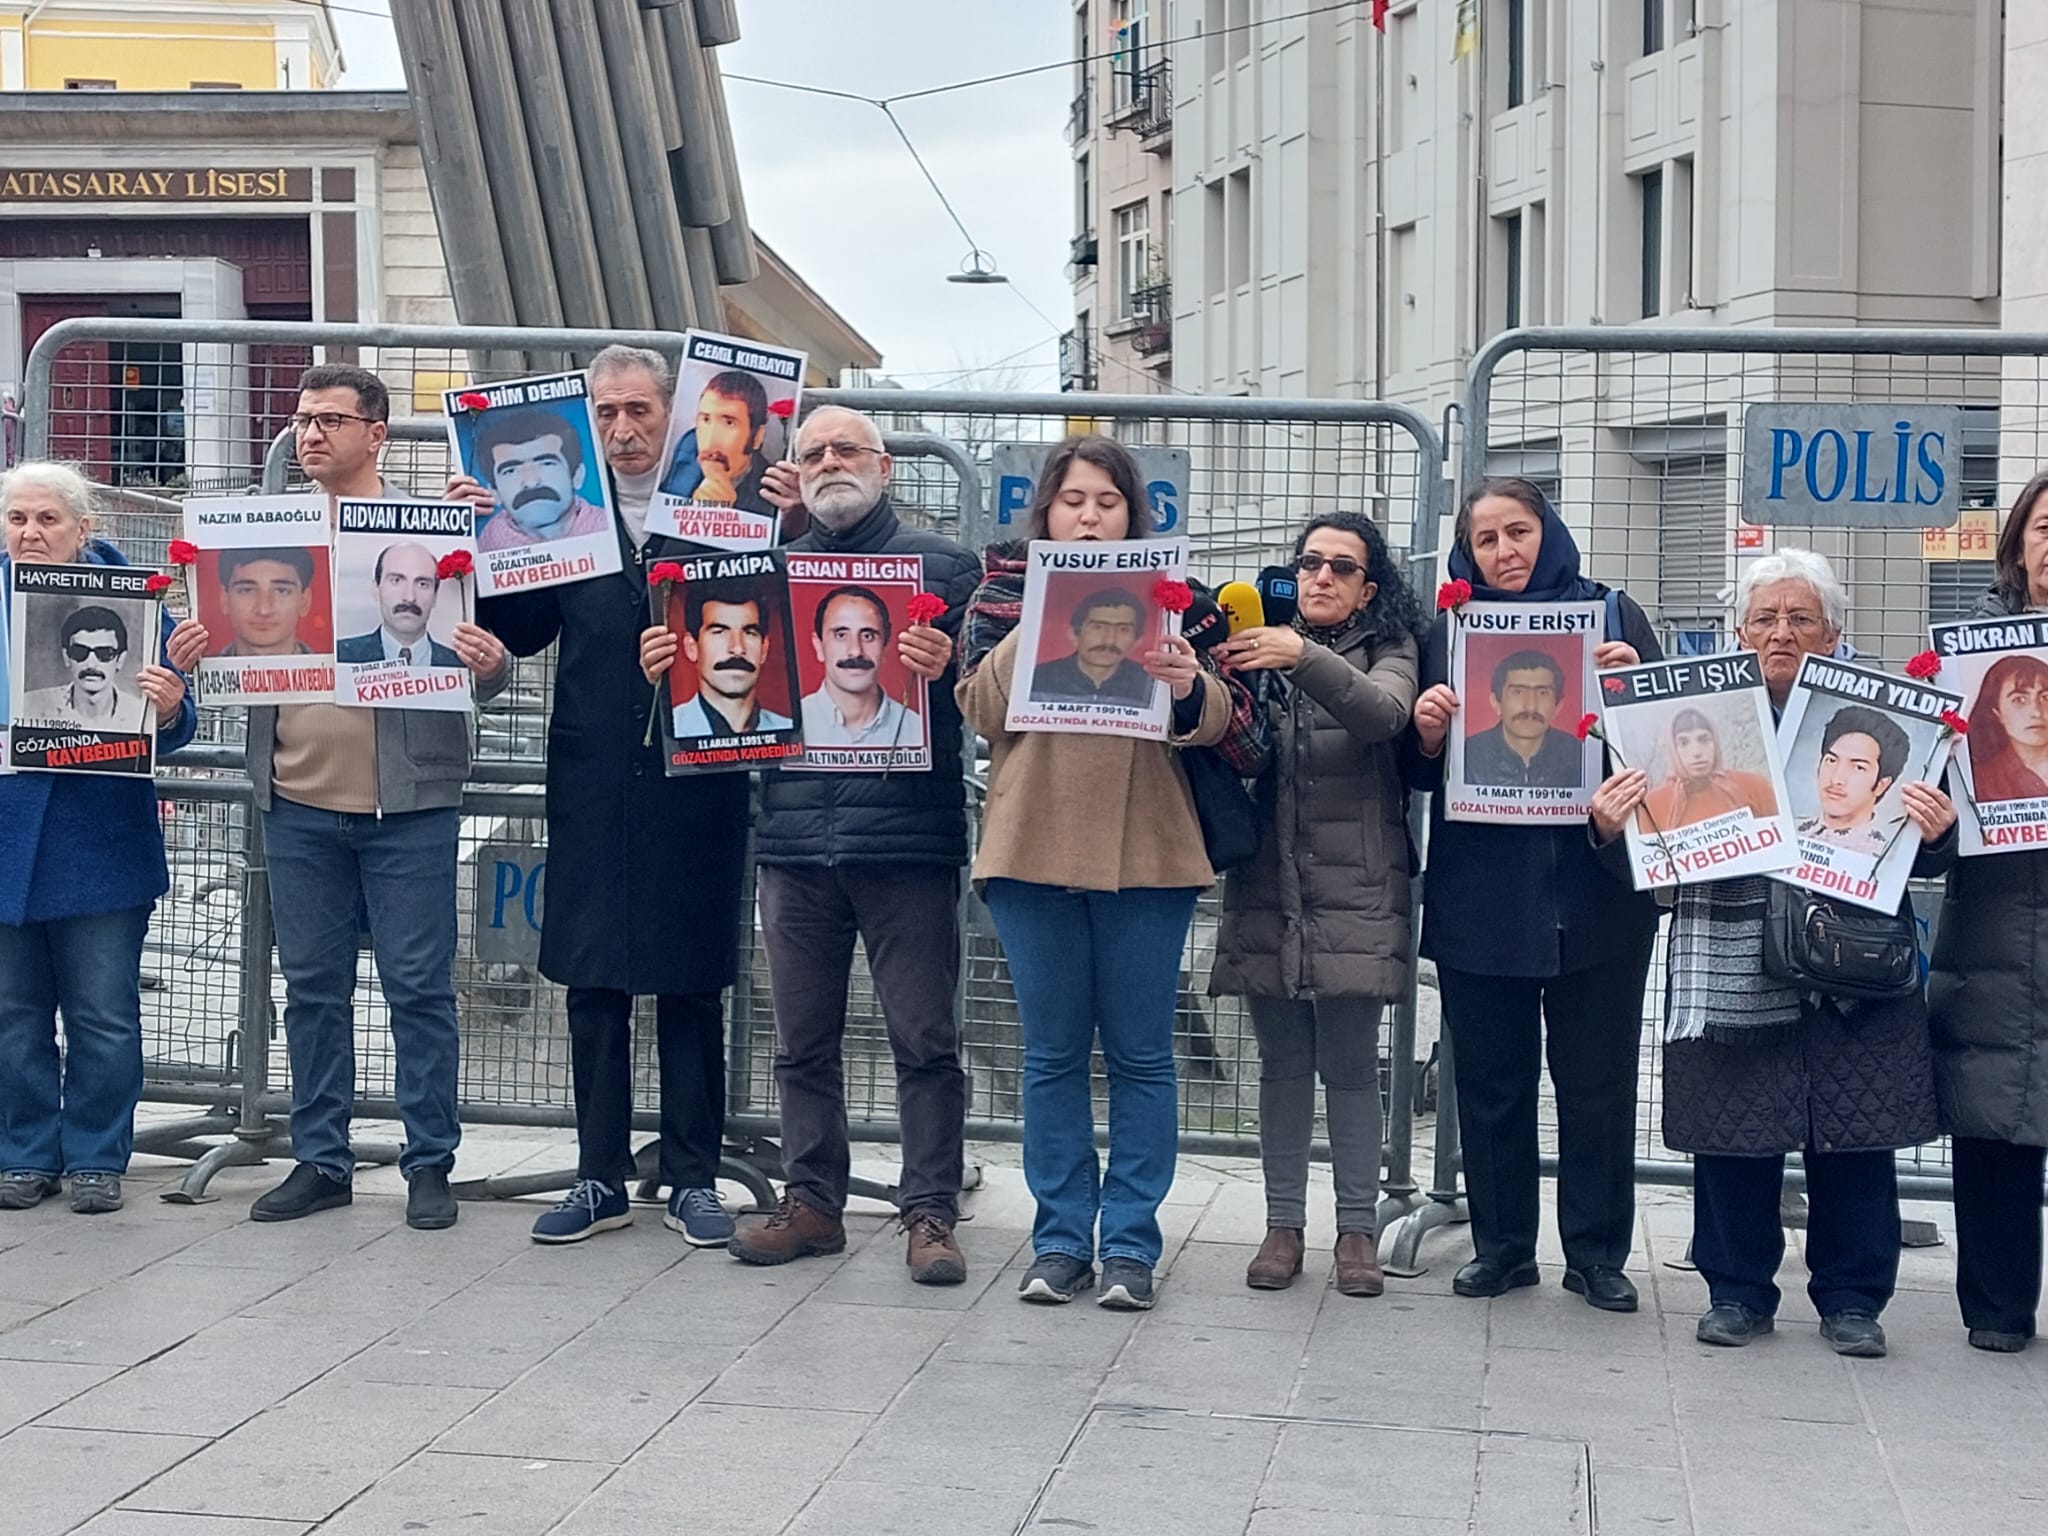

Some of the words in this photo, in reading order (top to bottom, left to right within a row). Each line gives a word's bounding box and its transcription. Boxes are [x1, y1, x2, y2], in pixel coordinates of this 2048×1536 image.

[0, 172, 174, 197] ATASARAY
[185, 168, 288, 197] LİSESİ
[527, 376, 584, 402] DEMİR
[1766, 421, 1945, 505] POLİS
[199, 512, 242, 525] NAZIM
[246, 508, 322, 524] BABAOĞLU
[342, 506, 396, 530] RIDVAN
[400, 507, 471, 536] KARAKOÇ
[673, 508, 740, 522] GÖZALTINDA
[490, 553, 553, 572] GÖZALTINDA
[717, 554, 776, 578] AKİPA
[852, 560, 919, 579] BİLGİN
[1039, 551, 1110, 569] YUSUF
[1116, 545, 1180, 571] ERİŞTİ
[19, 570, 104, 589] HAYRETTİN
[493, 552, 596, 589] KAYBEDİLDİ
[1457, 612, 1522, 630] YUSUF
[1529, 610, 1596, 634] ERİŞTİ
[1943, 623, 2036, 657] ŞÜKRAN
[242, 665, 291, 693] GÖZALTINDA
[354, 670, 410, 686] GÖZALTINDA
[357, 670, 464, 702] KAYBEDİLDİ
[1632, 667, 1691, 697] ELİF
[1699, 660, 1754, 690] IŞIK
[1803, 662, 1884, 700] MURAT
[1040, 703, 1054, 711] 14
[1057, 705, 1091, 713] MART
[1012, 715, 1087, 726] GÖZALTINDA
[1092, 719, 1163, 734] KAYBEDİLDİ
[15, 733, 103, 753] GÖZALTINDA
[672, 747, 740, 765] GÖZALTINDA
[1475, 787, 1488, 797] 14
[1492, 788, 1524, 798] MART
[1528, 789, 1573, 799] 1991'de
[1451, 801, 1524, 816] GÖZALTINDA
[1981, 811, 2047, 826] GÖZALTINDA
[1645, 821, 1783, 885] KAYBEDİLDİ
